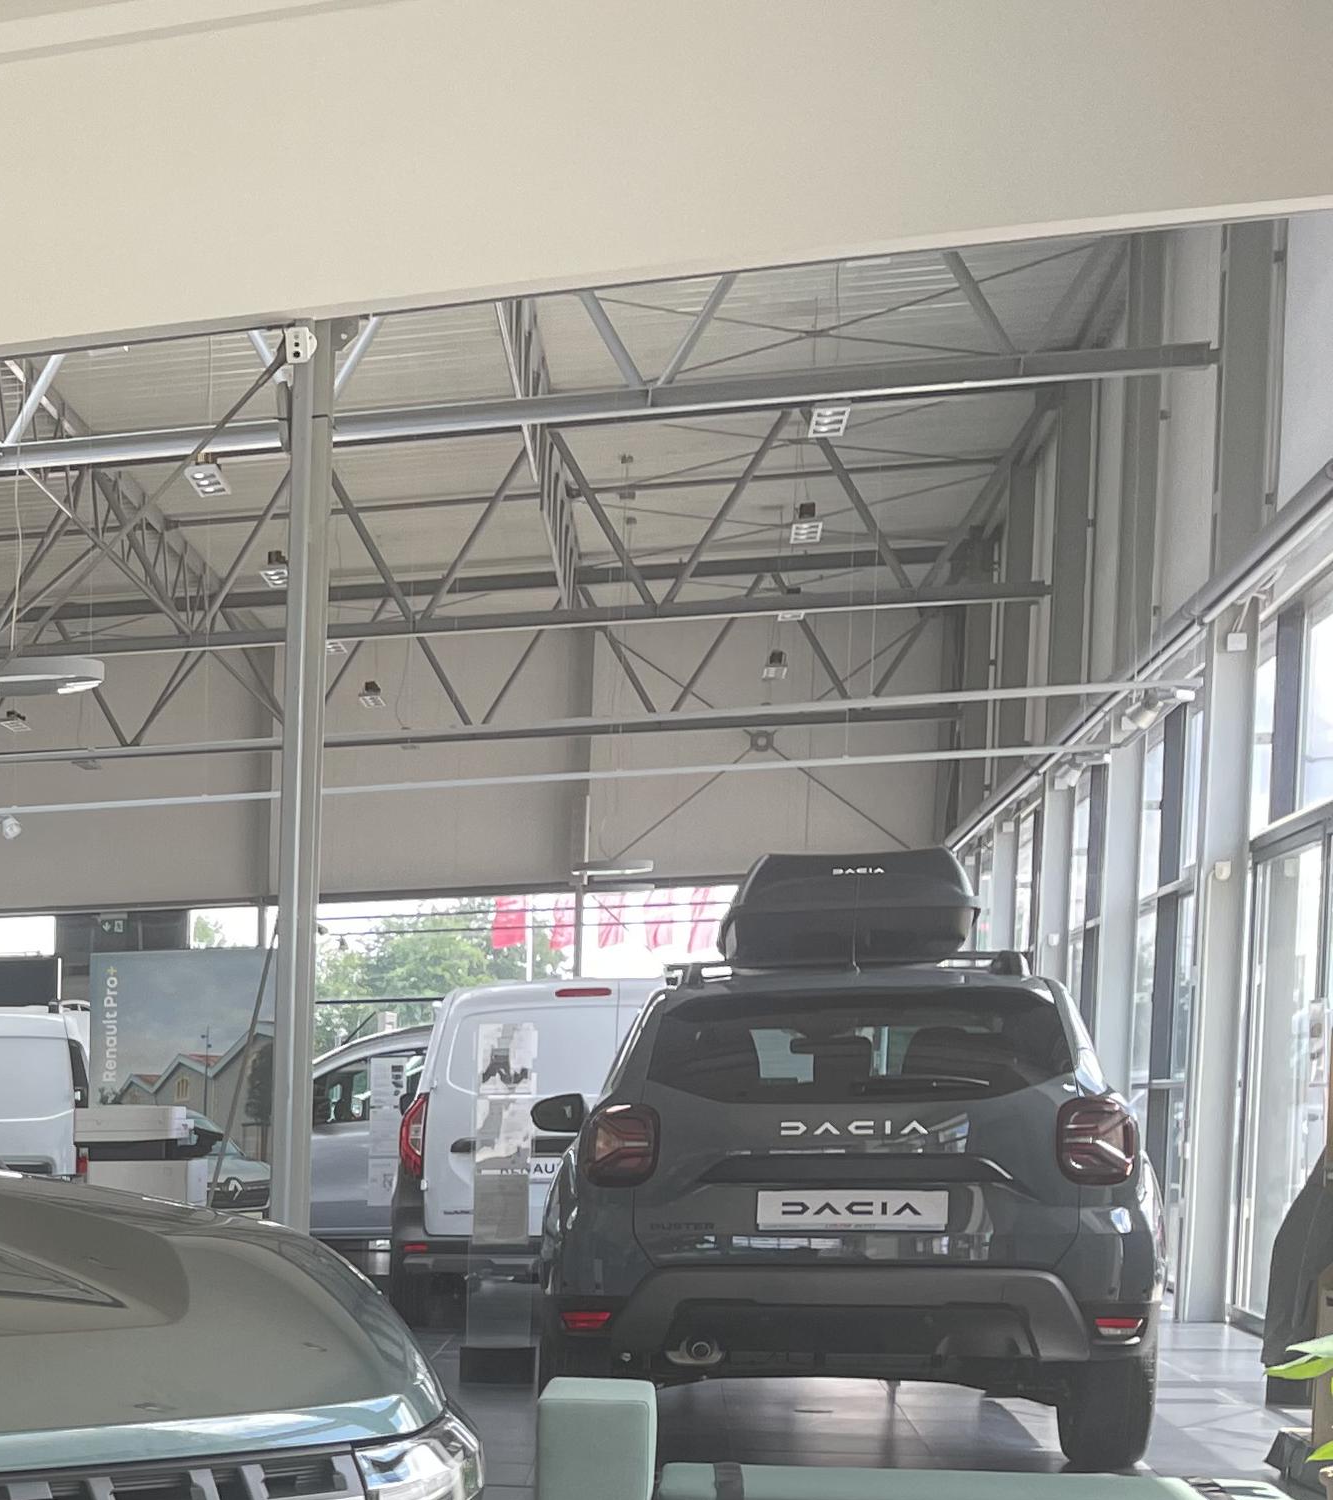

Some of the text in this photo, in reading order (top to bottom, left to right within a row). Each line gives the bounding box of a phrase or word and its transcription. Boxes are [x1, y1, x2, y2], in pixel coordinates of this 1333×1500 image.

[832, 867, 885, 875] DACIA
[102, 1011, 117, 1082] Renault
[780, 1120, 929, 1136] DACIA
[782, 1202, 923, 1216] DACIA
